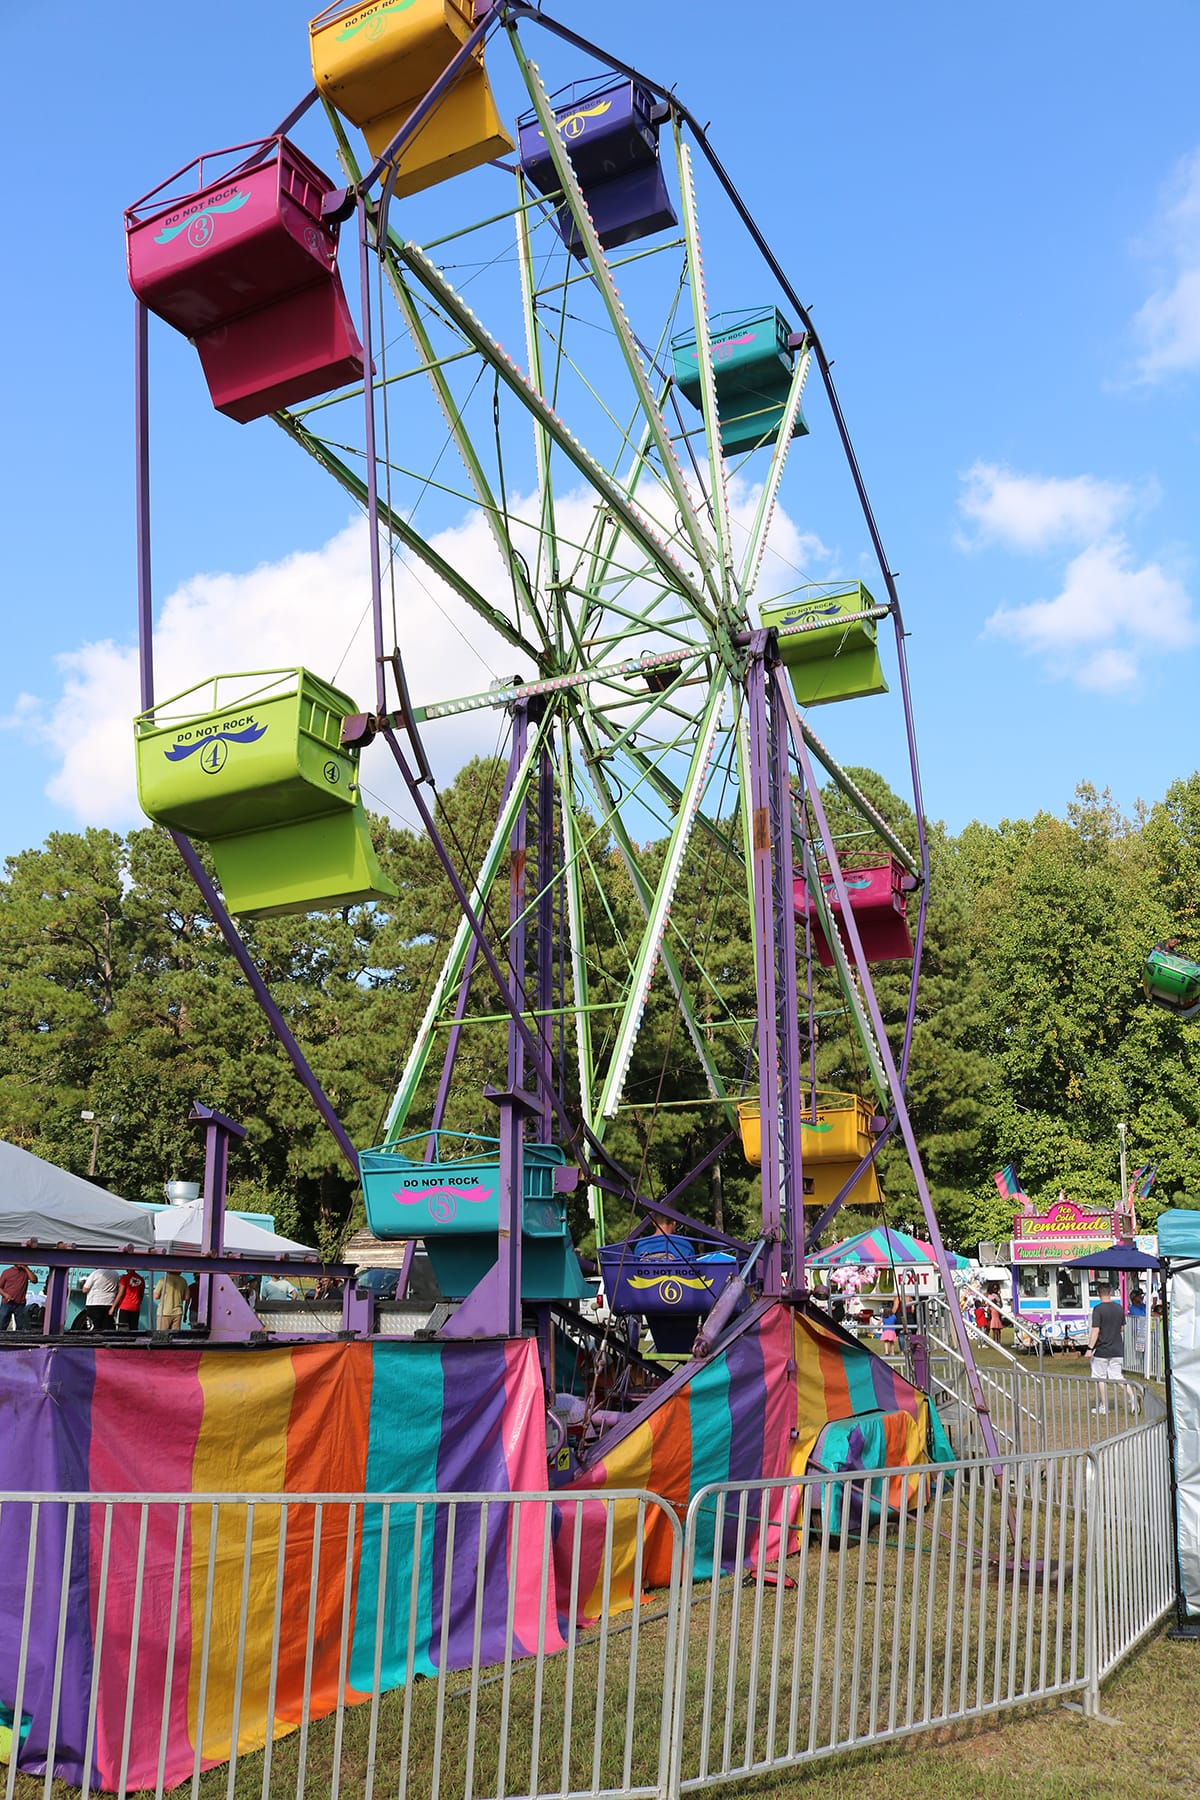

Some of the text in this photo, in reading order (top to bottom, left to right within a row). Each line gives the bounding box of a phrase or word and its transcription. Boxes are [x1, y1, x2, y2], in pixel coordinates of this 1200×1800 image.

[345, 17, 358, 28] DO
[360, 6, 379, 20] NOT
[165, 186, 238, 226] DO NOT ROCK
[194, 217, 208, 242] 3
[728, 330, 749, 340] ROCK
[177, 715, 255, 743] DO NOT ROCK
[205, 743, 219, 768] 4
[404, 1176, 480, 1187] DO NOT ROCK
[435, 1194, 450, 1218] 5
[1057, 1206, 1072, 1214] Ice
[1023, 1216, 1109, 1234] Lemonade
[1055, 1213, 1076, 1222] Cold
[664, 1281, 677, 1300] 6
[1041, 1320, 1088, 1338] ORE
